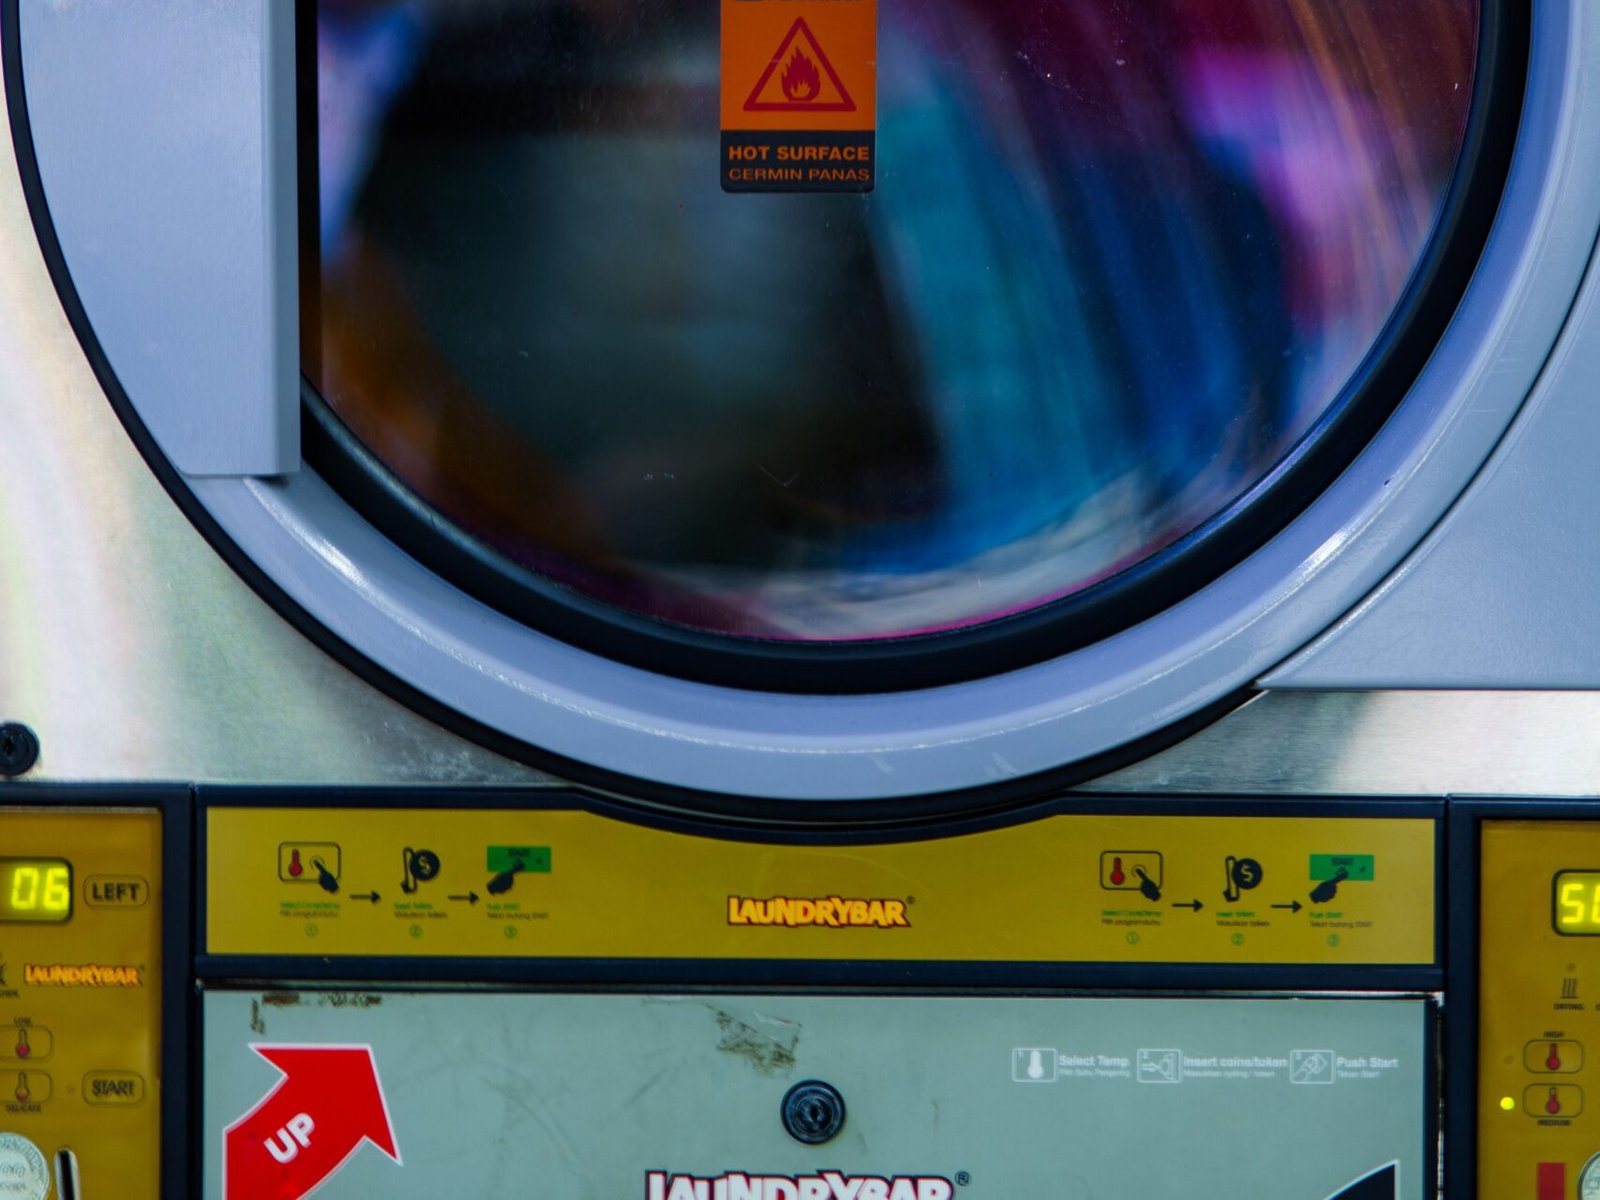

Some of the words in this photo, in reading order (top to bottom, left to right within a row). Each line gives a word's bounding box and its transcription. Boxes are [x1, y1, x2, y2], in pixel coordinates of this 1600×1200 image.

[729, 146, 770, 160] HOT
[777, 146, 869, 161] SURFACE
[729, 168, 802, 181] CERMIN
[809, 168, 870, 181] PANAS
[92, 883, 139, 901] LEFT
[727, 896, 912, 928] LAUNDRYBAR
[24, 963, 143, 988] LAUNDRYBAR
[1059, 1054, 1096, 1067] Select
[1097, 1054, 1130, 1069] Temp
[1183, 1055, 1218, 1068] Insert
[1336, 1056, 1367, 1068] Push
[1369, 1056, 1399, 1068] Start
[92, 1079, 136, 1098] START
[263, 1112, 315, 1164] UP
